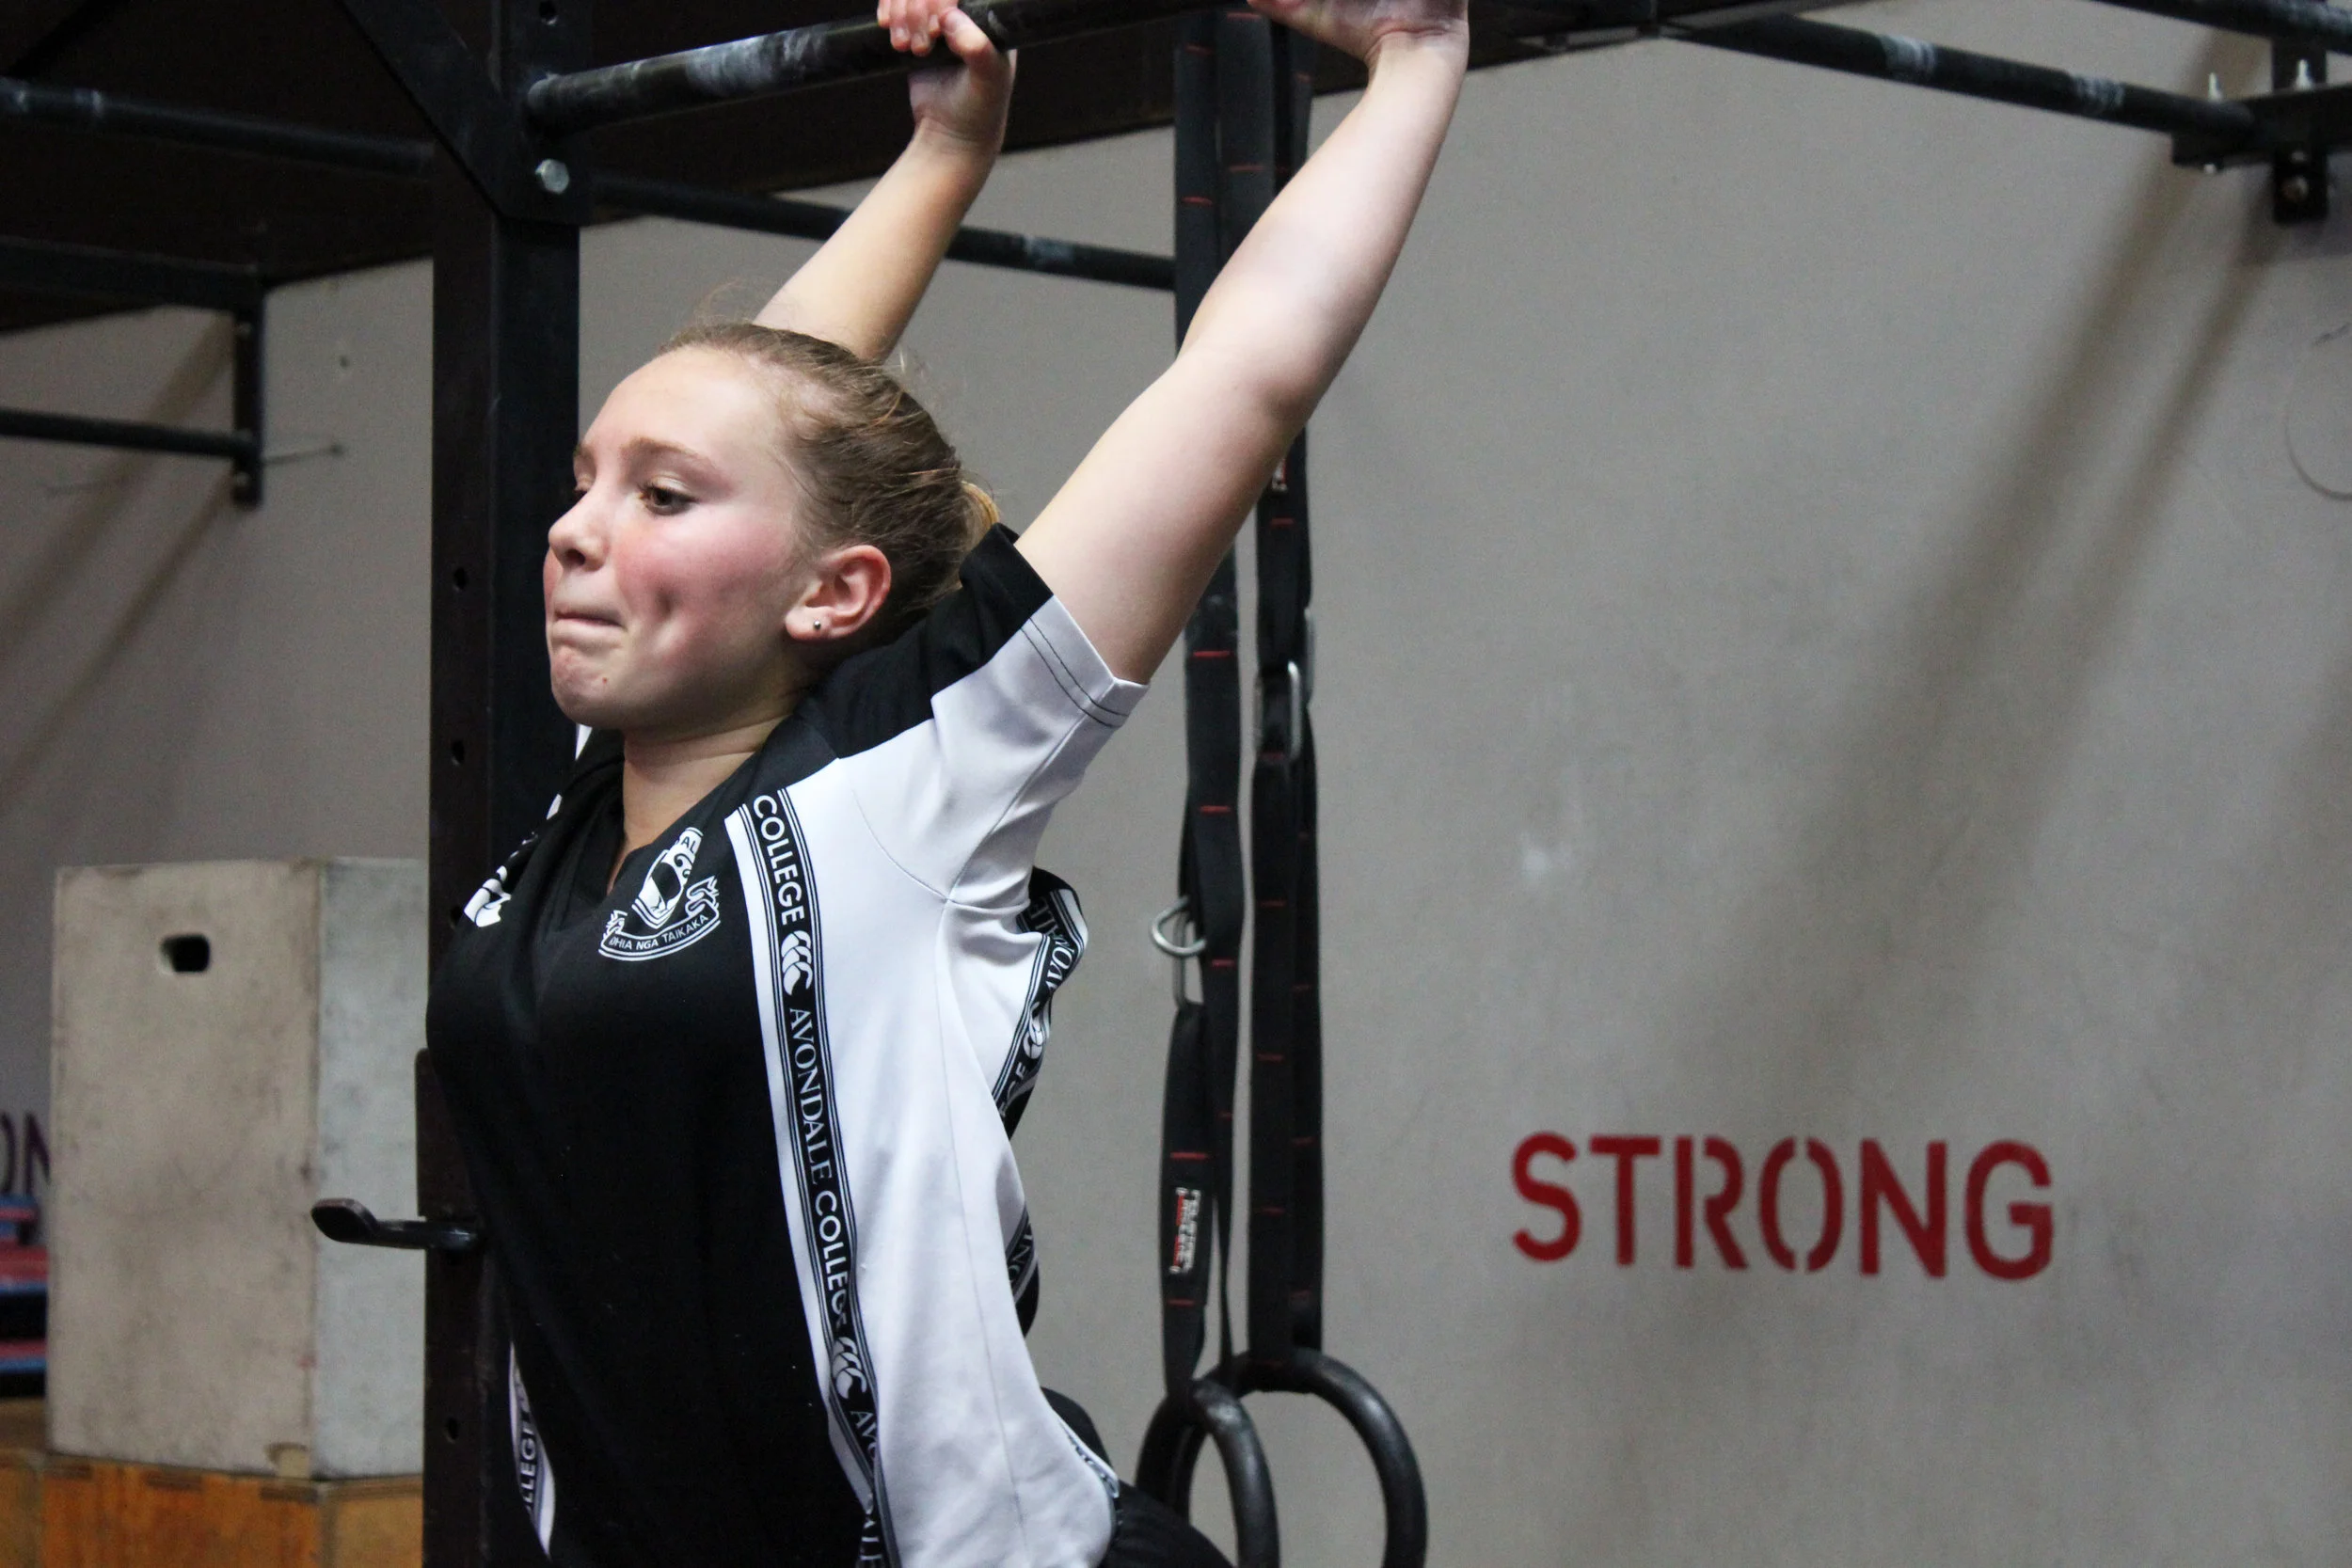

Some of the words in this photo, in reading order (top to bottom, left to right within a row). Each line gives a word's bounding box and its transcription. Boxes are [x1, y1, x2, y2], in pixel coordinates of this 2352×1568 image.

[635, 939, 660, 951] NGA
[660, 914, 709, 943] TAIKAKA
[753, 795, 805, 926] COLLEGE
[789, 1008, 833, 1185] AVONDALE
[1511, 1132, 2054, 1281] STRONG
